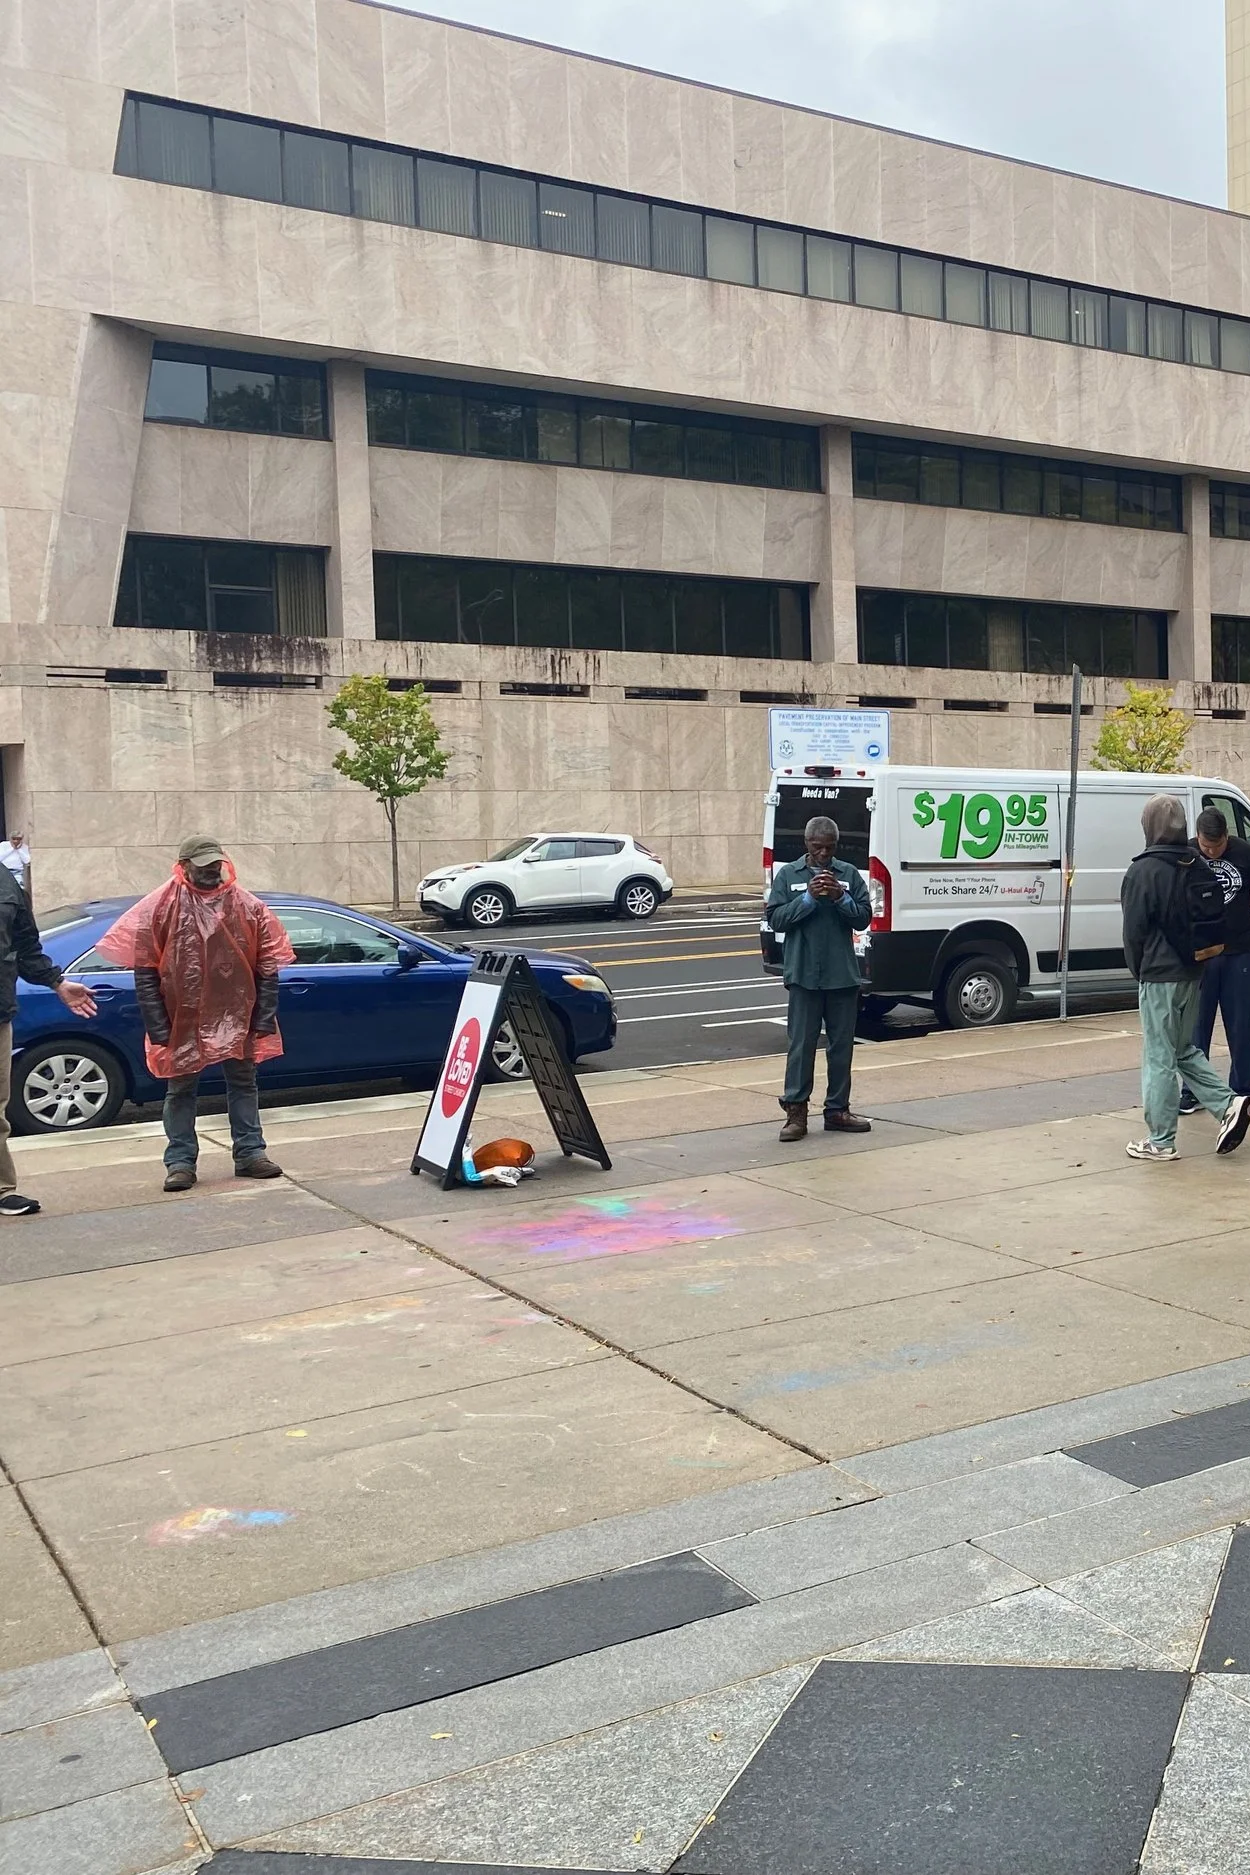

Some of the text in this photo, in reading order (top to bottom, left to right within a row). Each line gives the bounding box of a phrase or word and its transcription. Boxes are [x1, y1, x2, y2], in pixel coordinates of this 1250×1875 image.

[801, 787, 819, 798] Need
[824, 787, 840, 799] Van?
[1004, 833, 1049, 843] IN-TOWN
[923, 886, 949, 895] Truck
[951, 886, 977, 895] Share
[979, 884, 999, 895] 24/7
[457, 1035, 470, 1059] BE
[447, 1058, 473, 1085] LOVED
